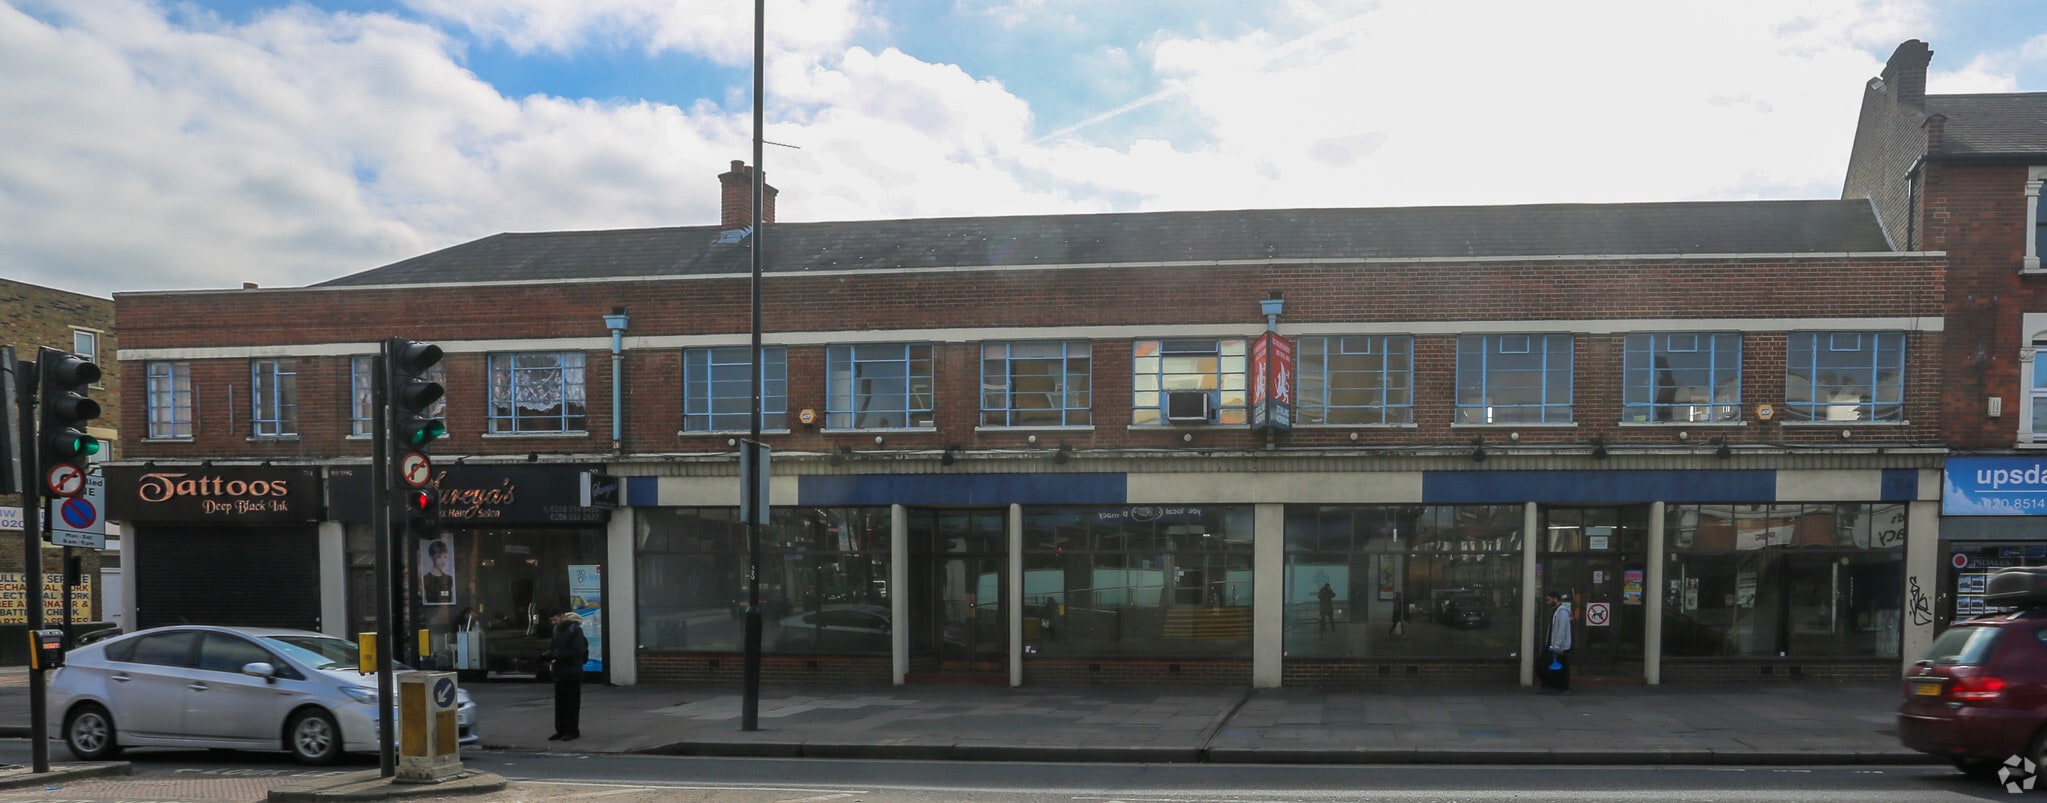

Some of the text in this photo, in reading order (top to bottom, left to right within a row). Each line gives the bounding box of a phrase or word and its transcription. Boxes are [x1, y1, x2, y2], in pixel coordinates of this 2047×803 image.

[138, 473, 289, 502] Tattoos
[202, 500, 288, 514] Deep Black Ink
[1983, 498, 2045, 509] 020 8514
[478, 509, 501, 518] Salon
